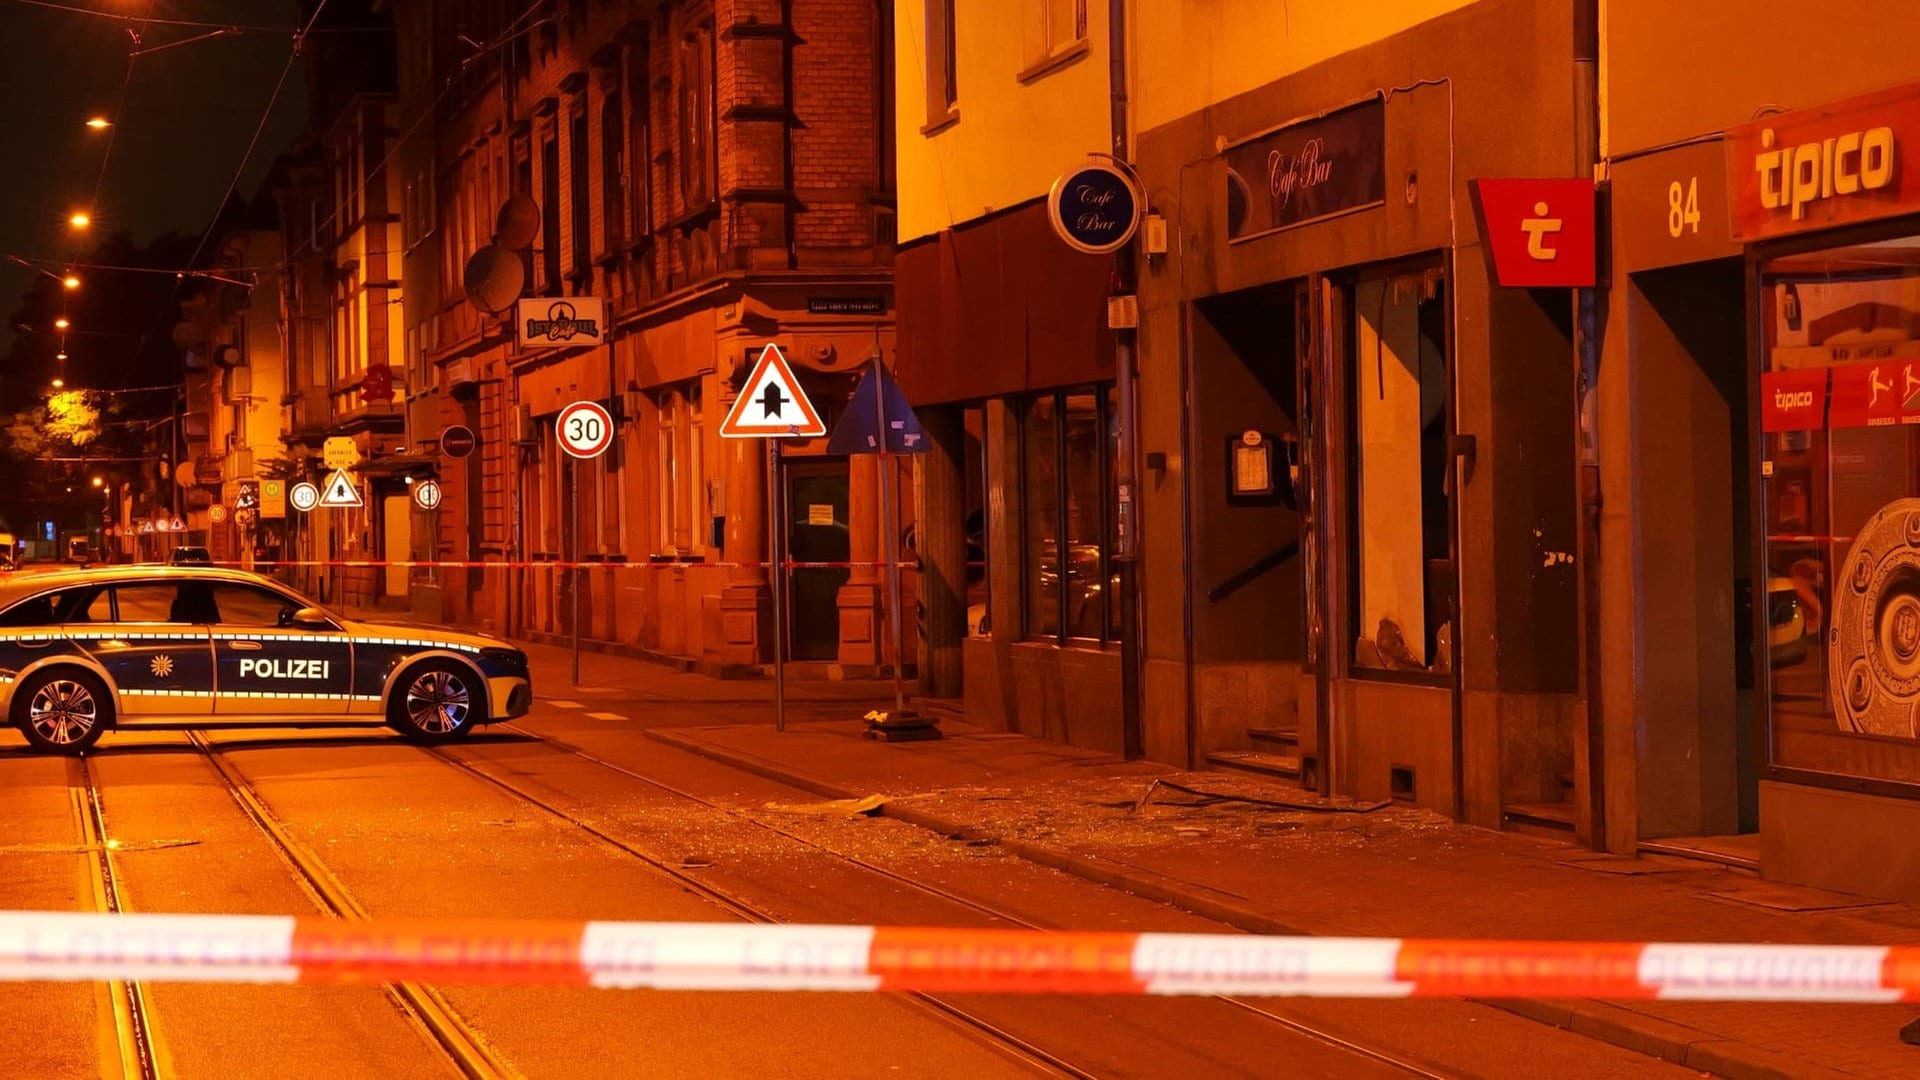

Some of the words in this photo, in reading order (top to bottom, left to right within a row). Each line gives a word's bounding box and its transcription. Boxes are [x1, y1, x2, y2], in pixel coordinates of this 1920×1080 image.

[1300, 137, 1333, 189] Bar
[1755, 128, 1894, 221] tipico
[1668, 176, 1701, 238] 84
[1077, 212, 1116, 231] Bar
[1774, 388, 1813, 412] tipico
[569, 418, 600, 442] 30
[297, 491, 313, 503] 30
[240, 659, 329, 679] POLIZEI
